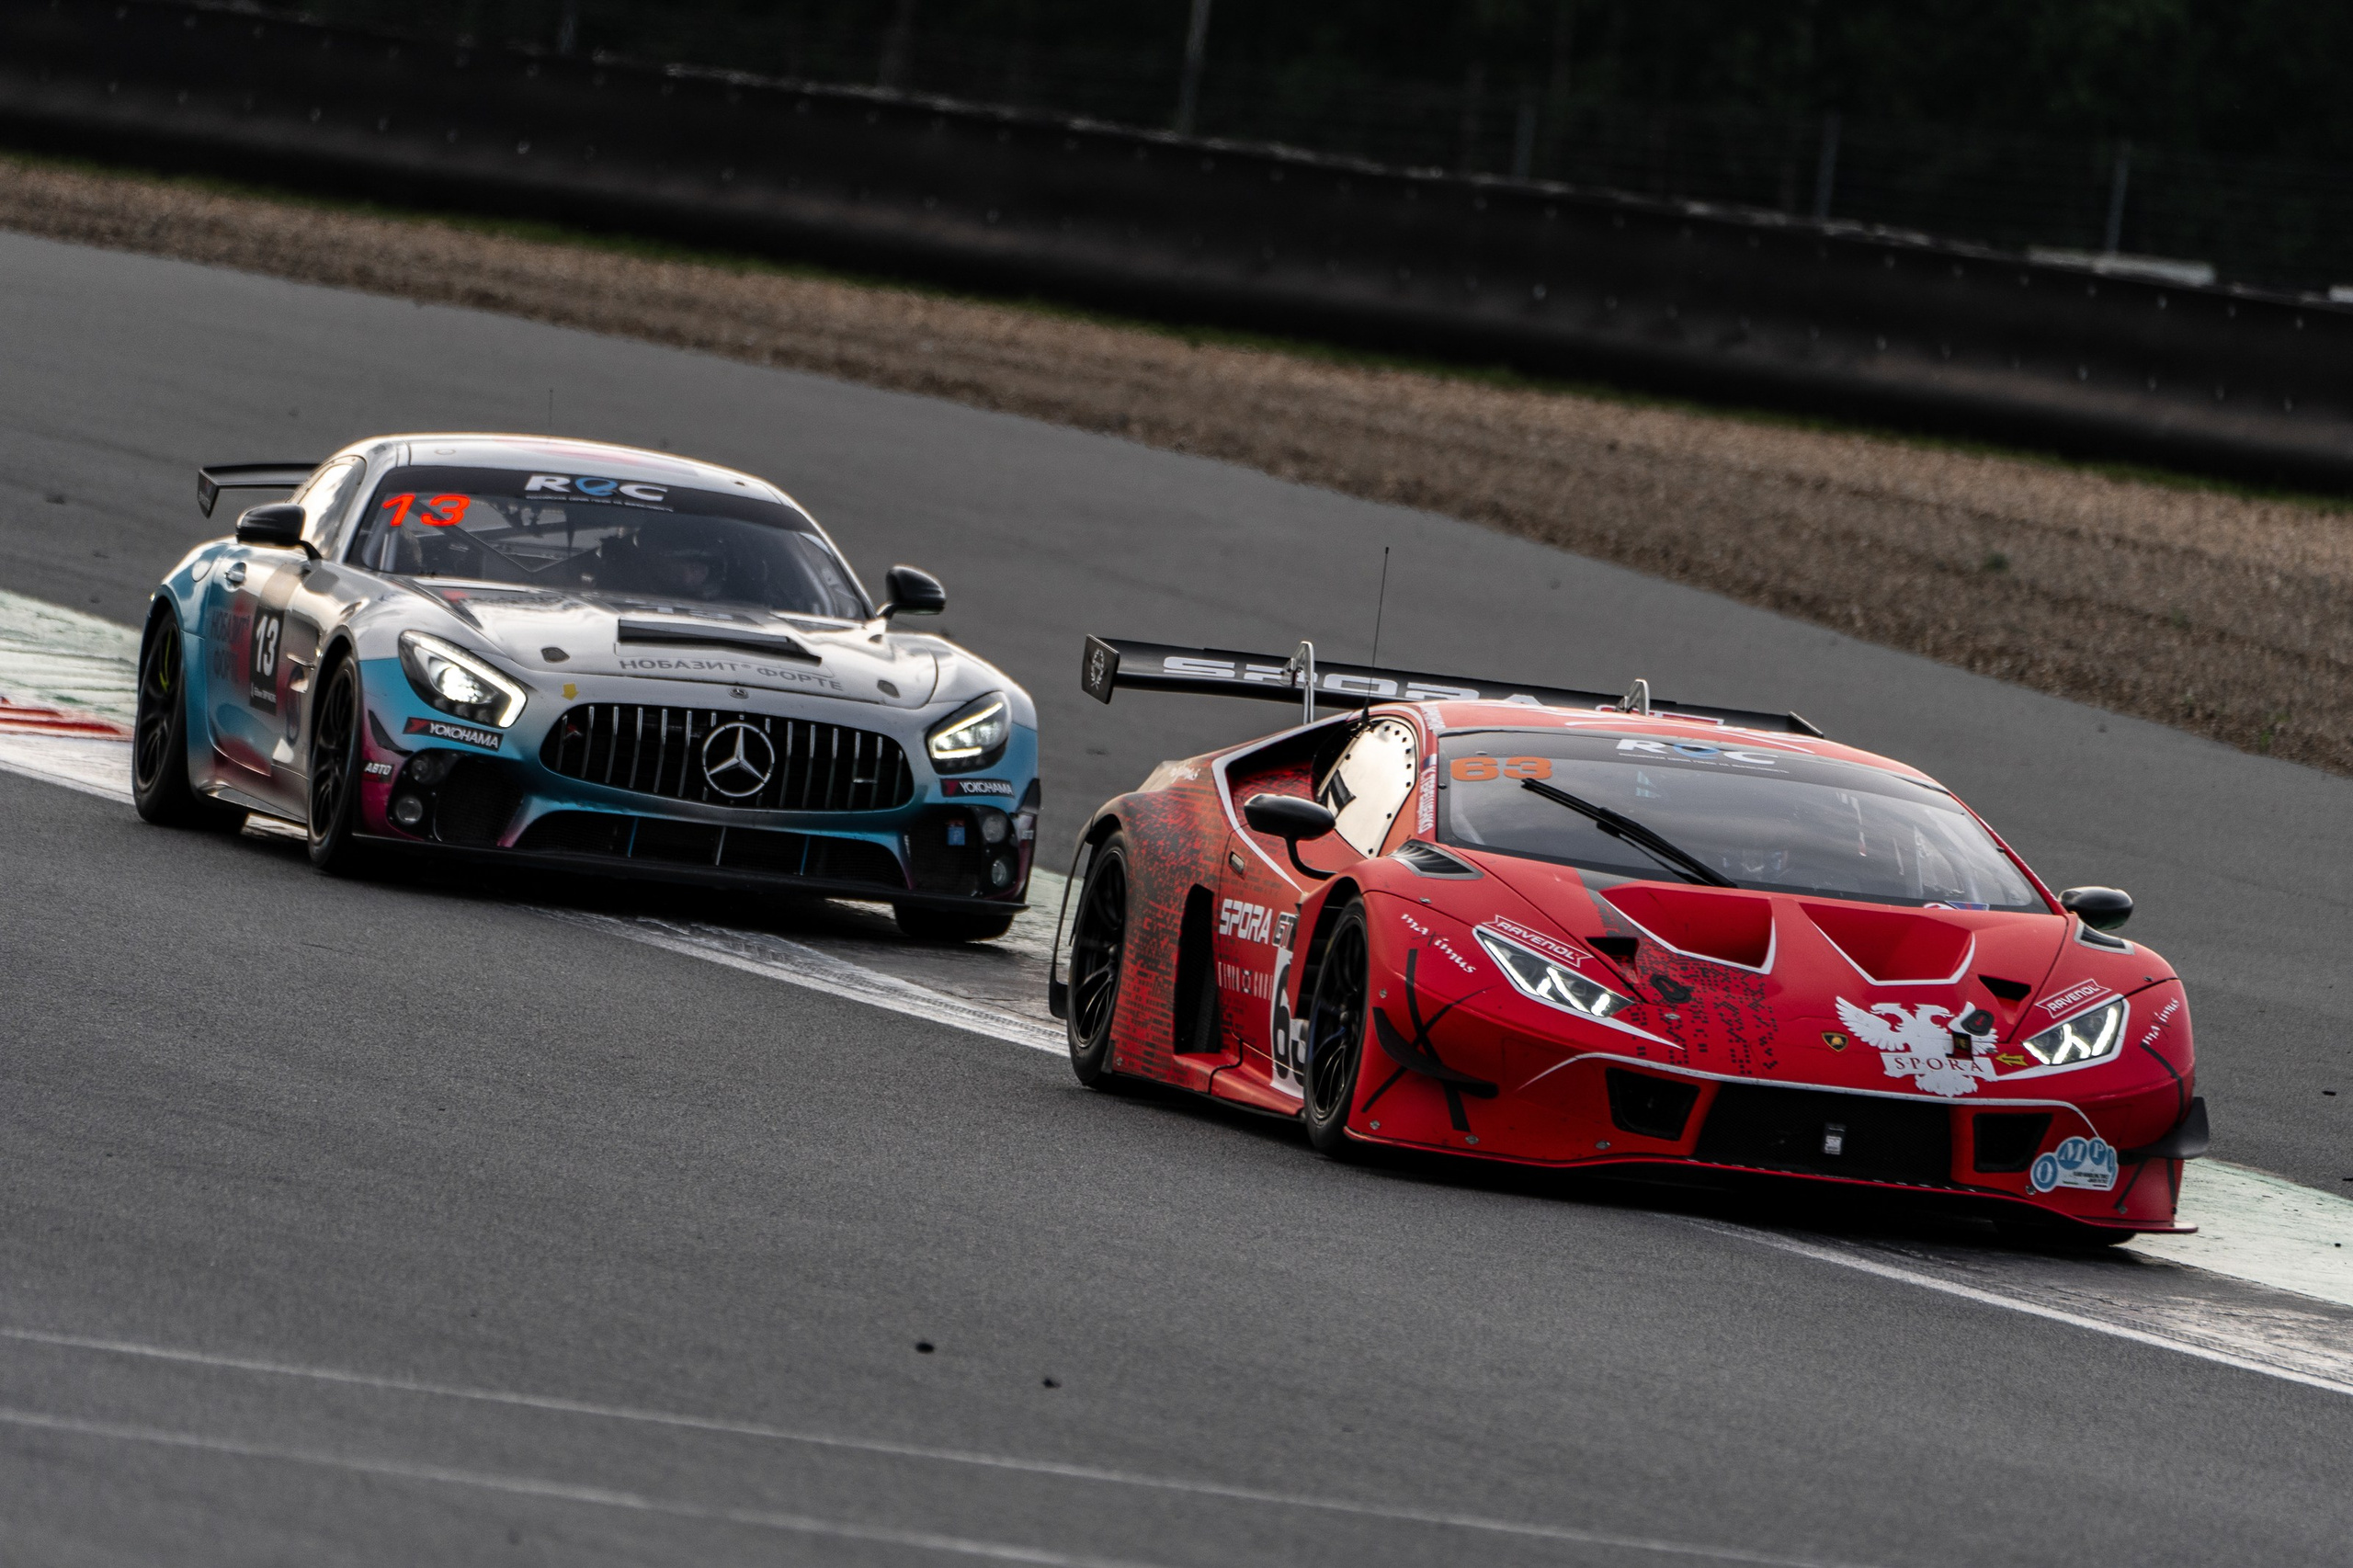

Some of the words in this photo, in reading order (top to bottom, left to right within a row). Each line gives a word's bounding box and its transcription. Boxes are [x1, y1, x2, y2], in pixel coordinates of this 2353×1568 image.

[381, 493, 471, 527] 13
[256, 614, 279, 676] 13
[756, 667, 843, 690] ФОРТЕ
[429, 722, 499, 748] YOKOHAMA
[1449, 756, 1553, 781] 63
[959, 781, 1014, 795] YOKOHAMA
[1219, 898, 1273, 945] SPORA
[1496, 921, 1577, 960] RAVENOL
[2046, 984, 2100, 1012] RAVENOL
